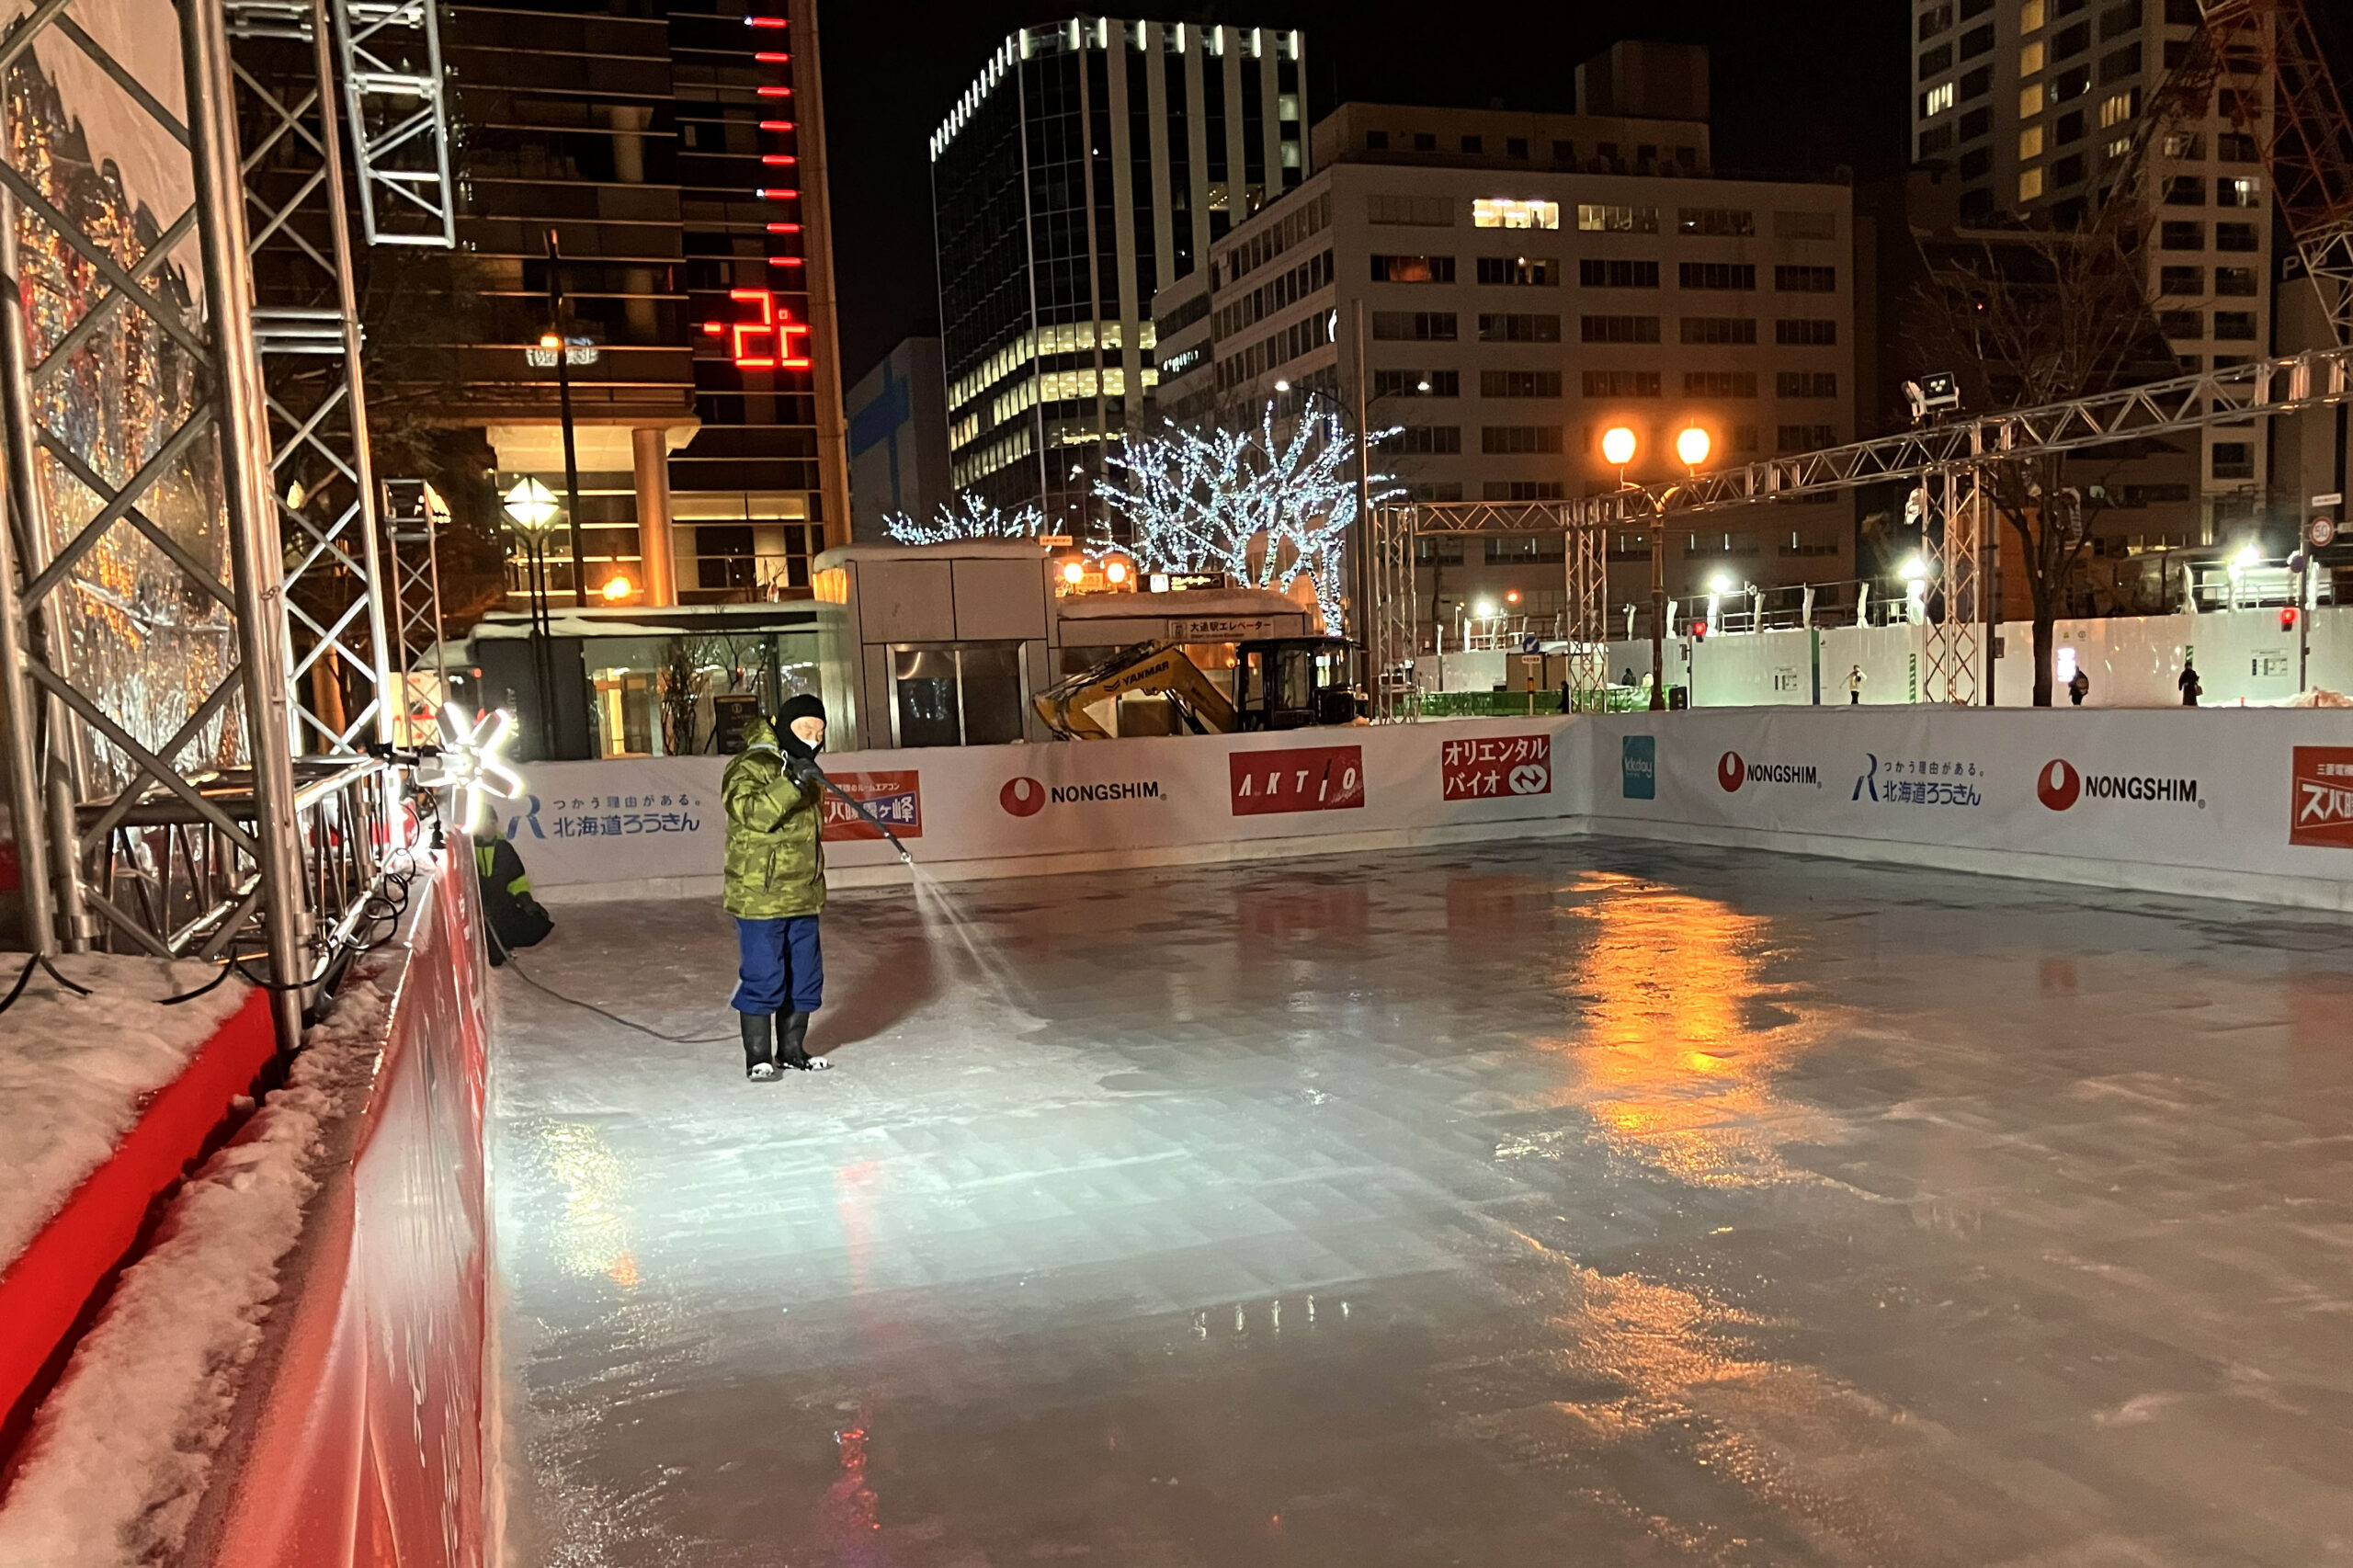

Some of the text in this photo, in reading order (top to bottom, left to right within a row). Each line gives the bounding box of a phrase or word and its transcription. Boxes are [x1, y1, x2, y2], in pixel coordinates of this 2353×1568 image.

[2314, 525, 2328, 539] 50
[1190, 620, 1271, 632] 大通駅エレベーター
[1122, 661, 1169, 687] YANMAR
[1444, 737, 1549, 766] オリエンタル
[1238, 758, 1357, 802] AKTIO
[1746, 764, 1817, 784] NONGSHIM
[1883, 760, 1984, 778] つかう理由がある。
[1051, 781, 1159, 803] NONGSHIM
[1445, 769, 1501, 796] バイオ
[1882, 780, 1982, 806] 北海道ろうきん
[2086, 775, 2198, 802] NONGSHIM
[553, 793, 701, 810] つかう理由がある。
[553, 812, 700, 838] 北海道ろうきん
